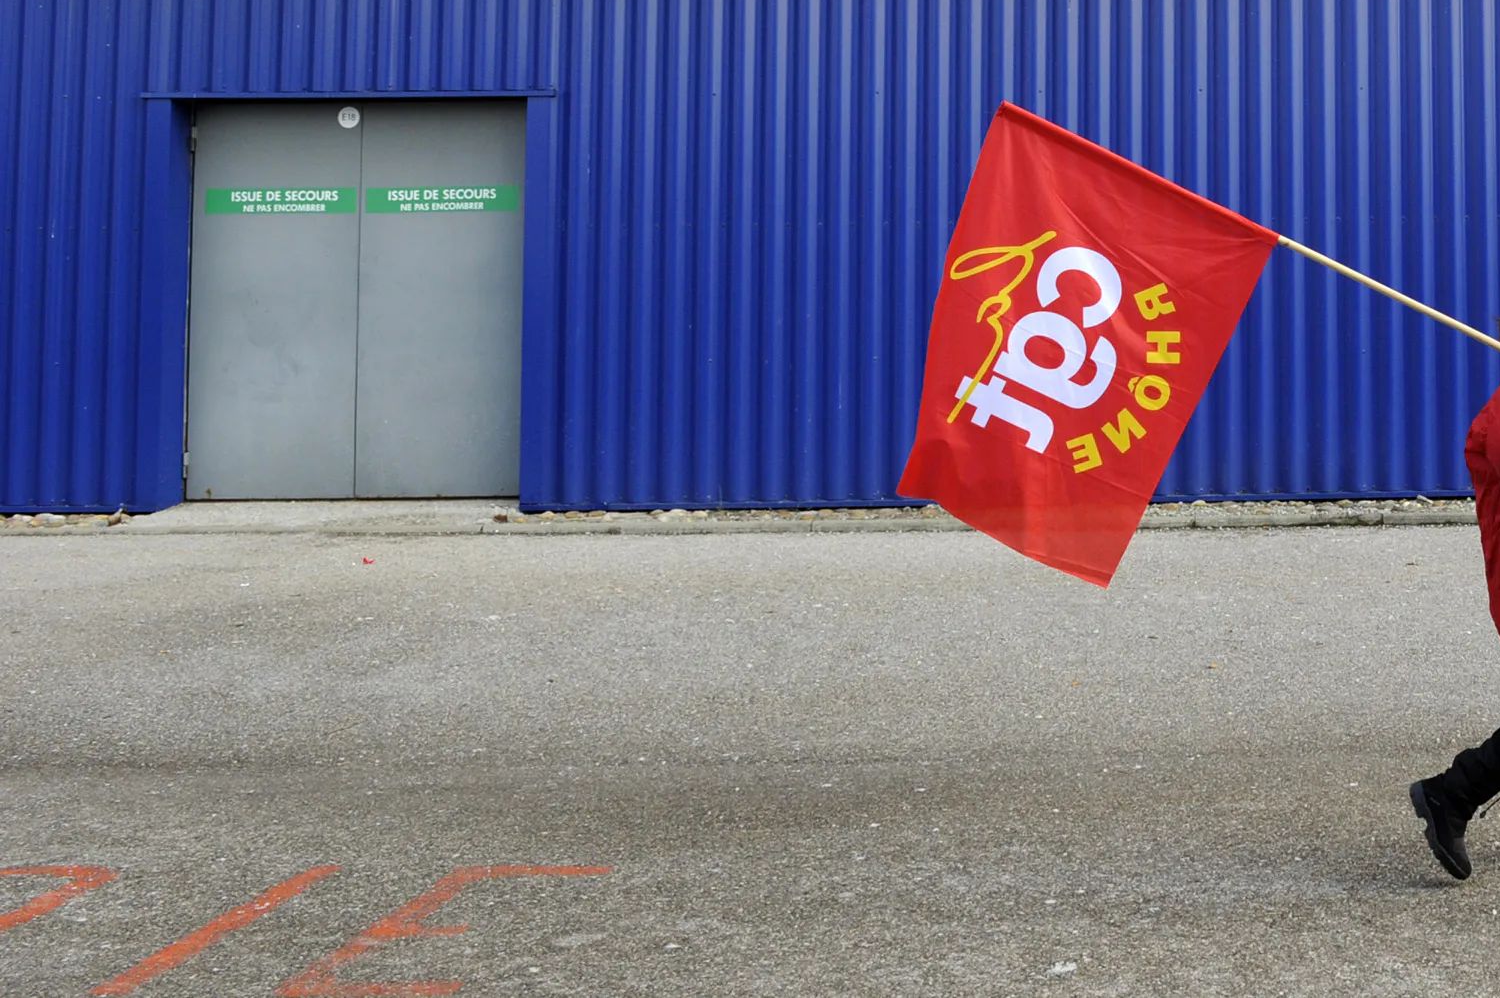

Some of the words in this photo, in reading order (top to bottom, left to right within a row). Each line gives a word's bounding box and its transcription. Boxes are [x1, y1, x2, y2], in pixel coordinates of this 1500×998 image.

[231, 191, 262, 202] ISSUE
[266, 190, 281, 201] DE
[285, 190, 339, 201] SECOURS
[387, 189, 420, 201] ISSUE
[423, 189, 439, 200] DE
[442, 188, 497, 200] SECOURS
[243, 204, 254, 212] NE
[256, 204, 271, 212] PAS
[273, 203, 326, 212] ENCOMBRER
[400, 203, 412, 211] NE
[414, 203, 430, 211] PAS
[431, 202, 484, 211] ENCOMBRER
